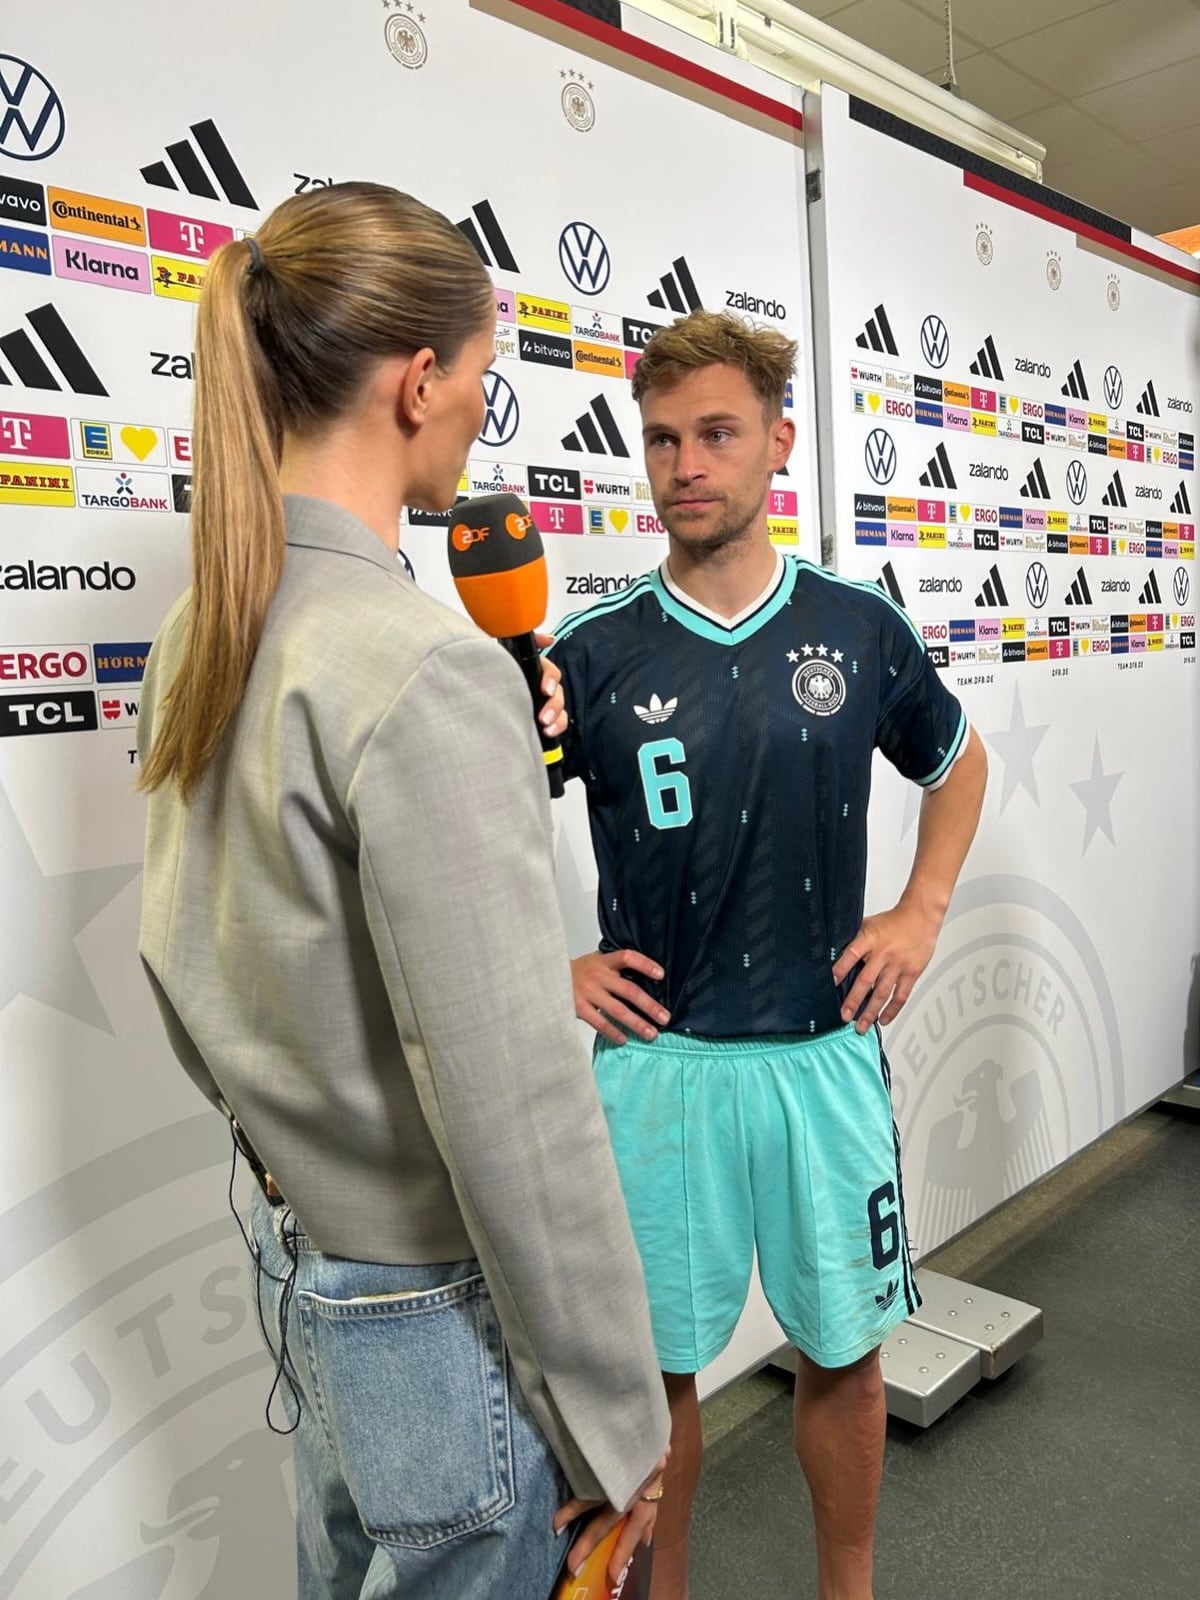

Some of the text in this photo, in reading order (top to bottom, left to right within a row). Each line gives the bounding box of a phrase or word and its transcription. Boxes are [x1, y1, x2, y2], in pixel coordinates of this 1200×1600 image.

[52, 200, 129, 229] Continental
[65, 248, 139, 281] Klarna
[531, 305, 568, 320] PANINI
[725, 290, 787, 320] zalando
[574, 325, 621, 342] TARGOBANK
[534, 341, 571, 360] bitvavo
[1015, 357, 1051, 378] zalando
[886, 399, 913, 418] ERGO
[1022, 402, 1043, 418] ERGO
[1167, 396, 1193, 414] zalando
[946, 412, 968, 426] Klarna
[1024, 426, 1042, 440] TCL
[1128, 425, 1143, 438] TCL
[86, 449, 110, 457] EDEKA
[969, 461, 1008, 481] zalando
[472, 481, 526, 494] TARGOBANK
[535, 474, 575, 493] TCL
[595, 482, 630, 496] WÜRTH
[1135, 484, 1162, 500] zalando
[81, 494, 169, 510] TARGOBANK
[975, 508, 997, 523] ERGO
[773, 525, 797, 534] PANINI
[1091, 519, 1106, 530] TCL
[891, 529, 914, 541] Klarna
[976, 533, 996, 546] TCL
[1129, 542, 1145, 554] ERGO
[0, 560, 136, 591] alando
[919, 576, 962, 593] zalando
[1101, 578, 1130, 593] zalando
[922, 624, 947, 640] ERGO
[1051, 620, 1068, 633] TCL
[1092, 640, 1109, 652] ERGO
[0, 651, 87, 680] ERGO
[928, 651, 946, 664] CL
[9, 701, 85, 726] TCL
[637, 737, 694, 830] 6
[867, 1180, 900, 1271] 6
